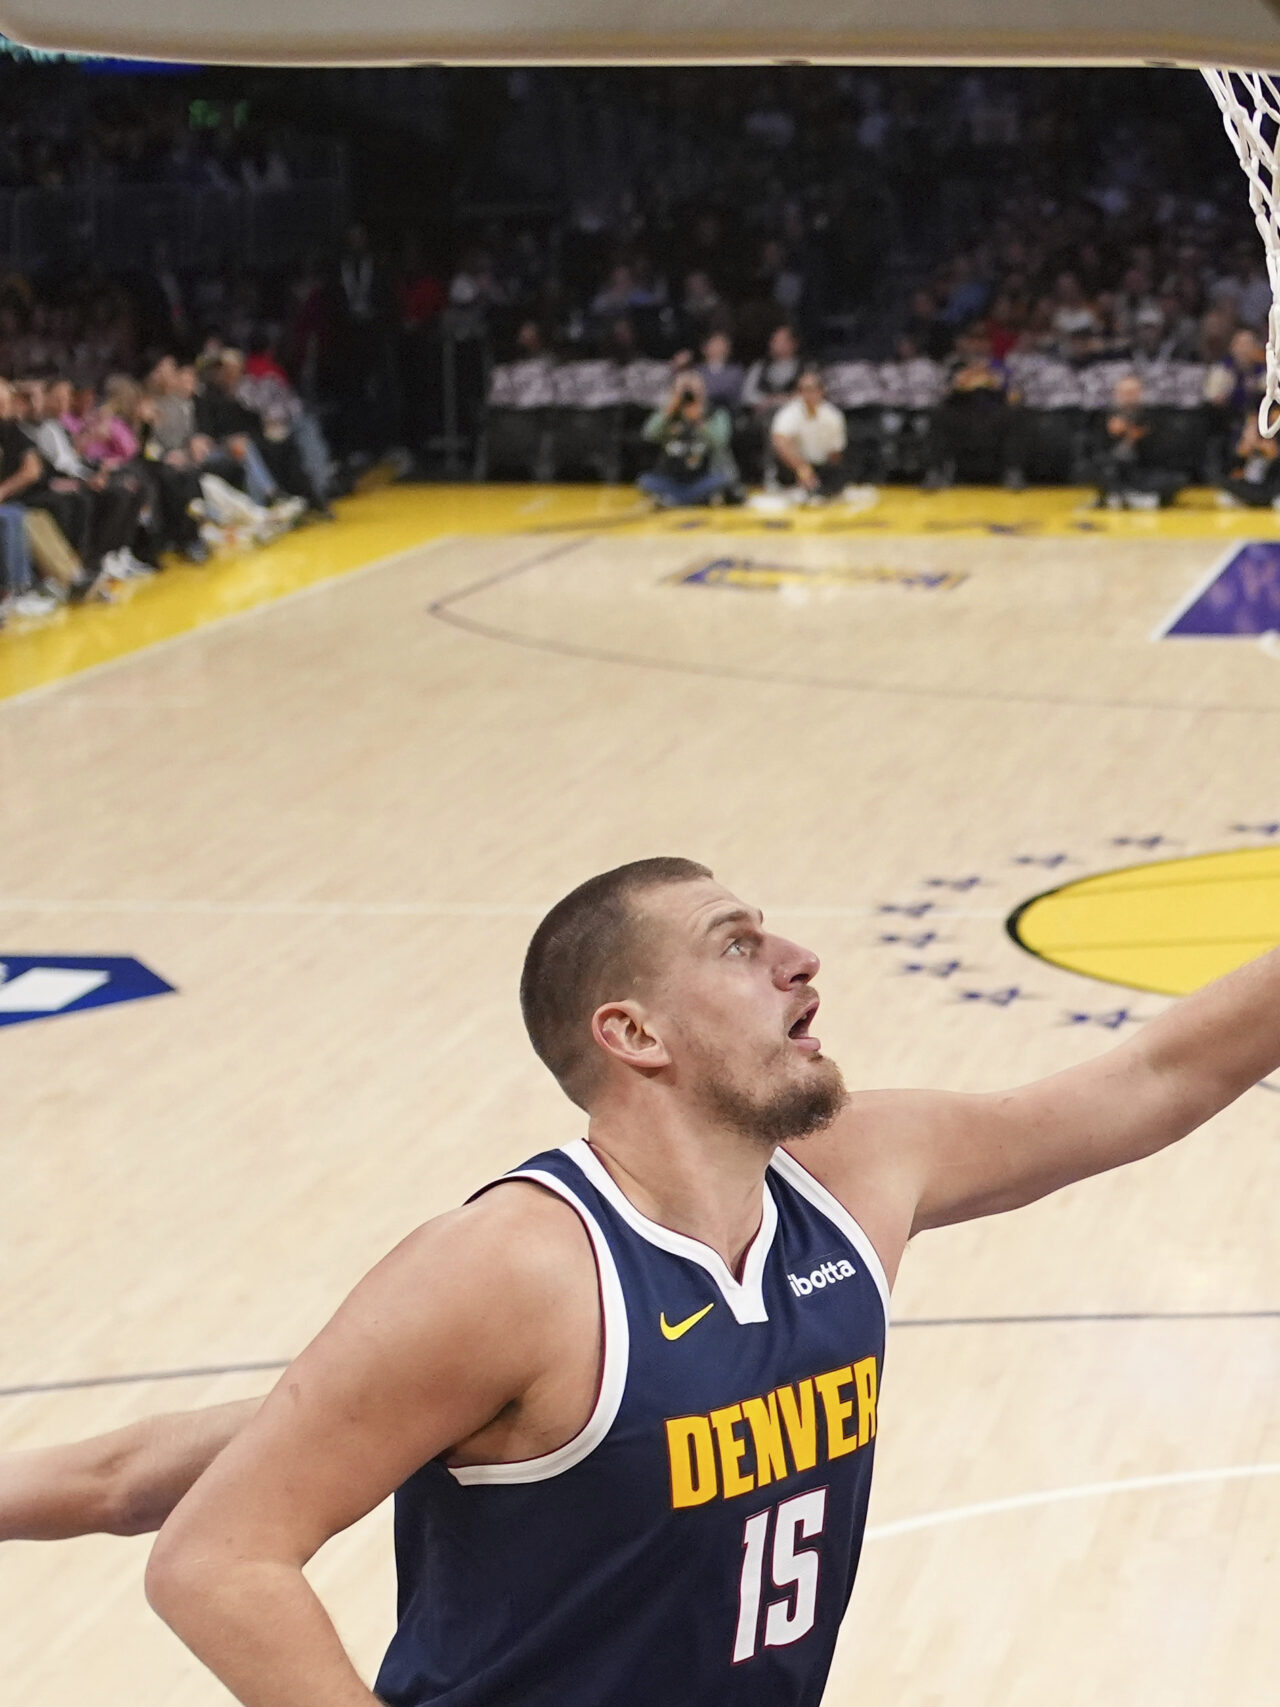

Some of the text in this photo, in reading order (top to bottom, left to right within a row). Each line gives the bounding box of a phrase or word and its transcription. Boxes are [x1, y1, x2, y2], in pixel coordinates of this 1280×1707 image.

[788, 1257, 858, 1298] ibotta
[664, 1355, 878, 1510] DENVER
[731, 1485, 829, 1667] 15
